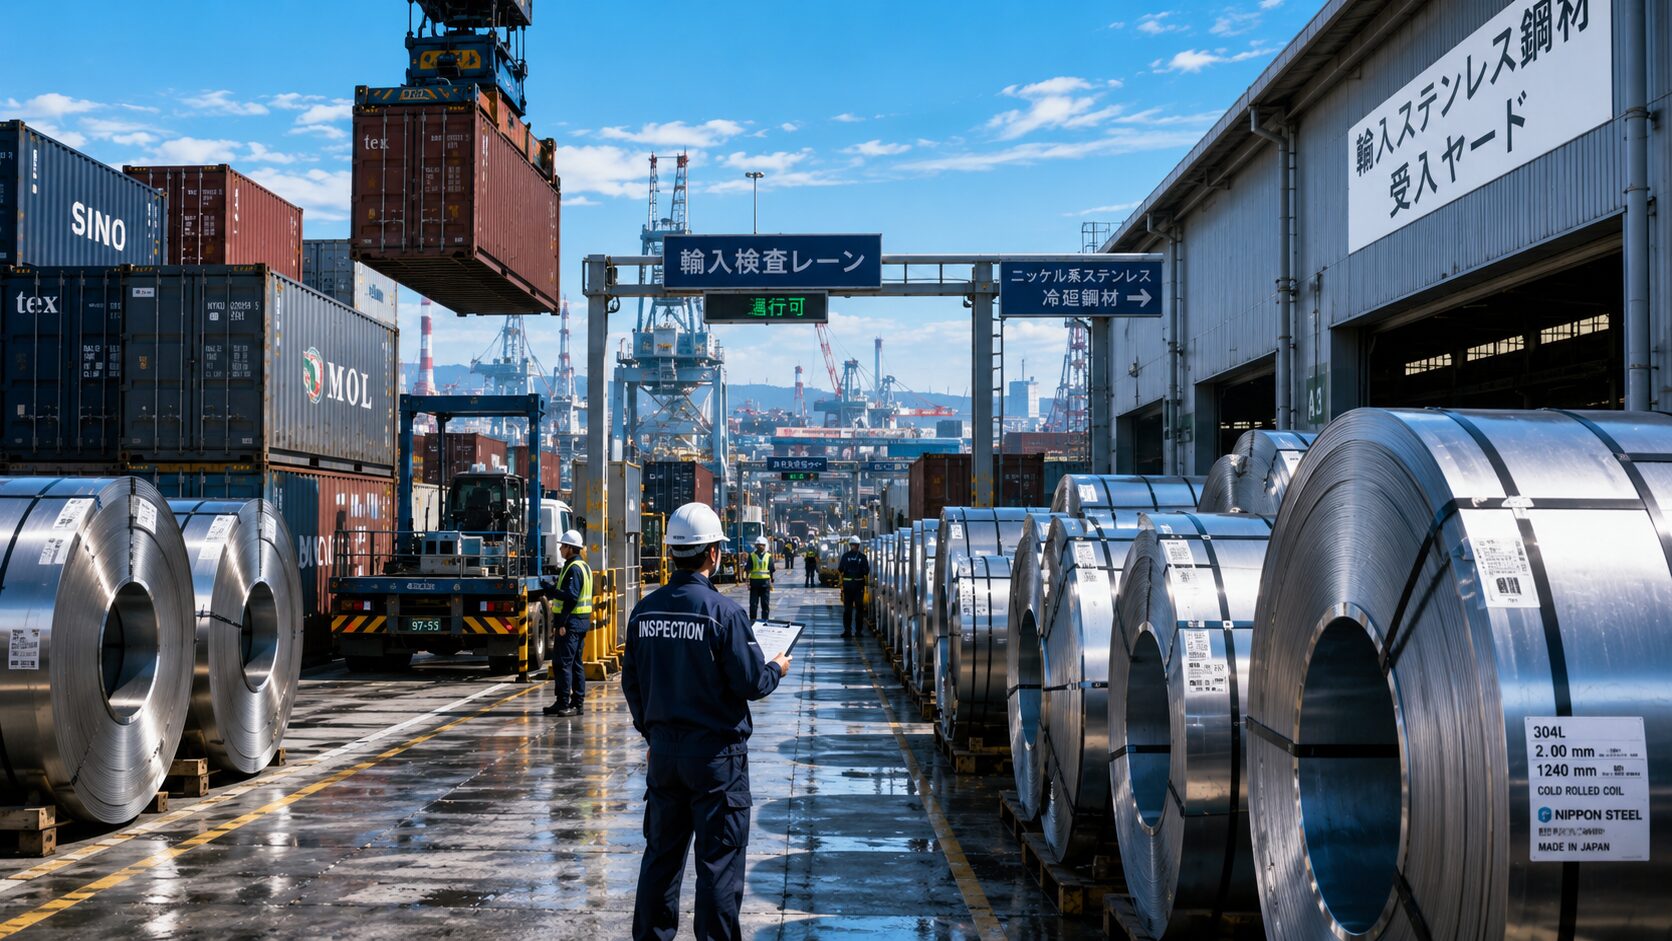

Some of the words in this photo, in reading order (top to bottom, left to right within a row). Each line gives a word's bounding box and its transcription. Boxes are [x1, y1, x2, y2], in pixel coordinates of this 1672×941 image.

[1356, 0, 1589, 177] 輸入ステンレス鋼材
[1389, 90, 1527, 218] 受入ヤード
[71, 201, 126, 252] SINO
[680, 248, 865, 275] 輸入検査レーン
[16, 290, 59, 314] tex
[327, 361, 372, 410] MOL
[1308, 386, 1322, 421] A3
[638, 620, 705, 642] INSPECTION
[1533, 725, 1566, 739] 304L
[1535, 744, 1567, 758] 2.00
[1572, 747, 1595, 758] mm
[1537, 763, 1569, 777] 1240
[1574, 767, 1597, 777] mm
[1538, 785, 1562, 796] COLD
[1566, 785, 1600, 796] ROLLED
[1603, 785, 1624, 796] COIL
[1555, 809, 1602, 821] NIPPON
[1605, 809, 1642, 821] STEEL
[1538, 842, 1565, 852] MADE
[1568, 842, 1578, 852] IN
[1580, 842, 1610, 852] JAPAN
